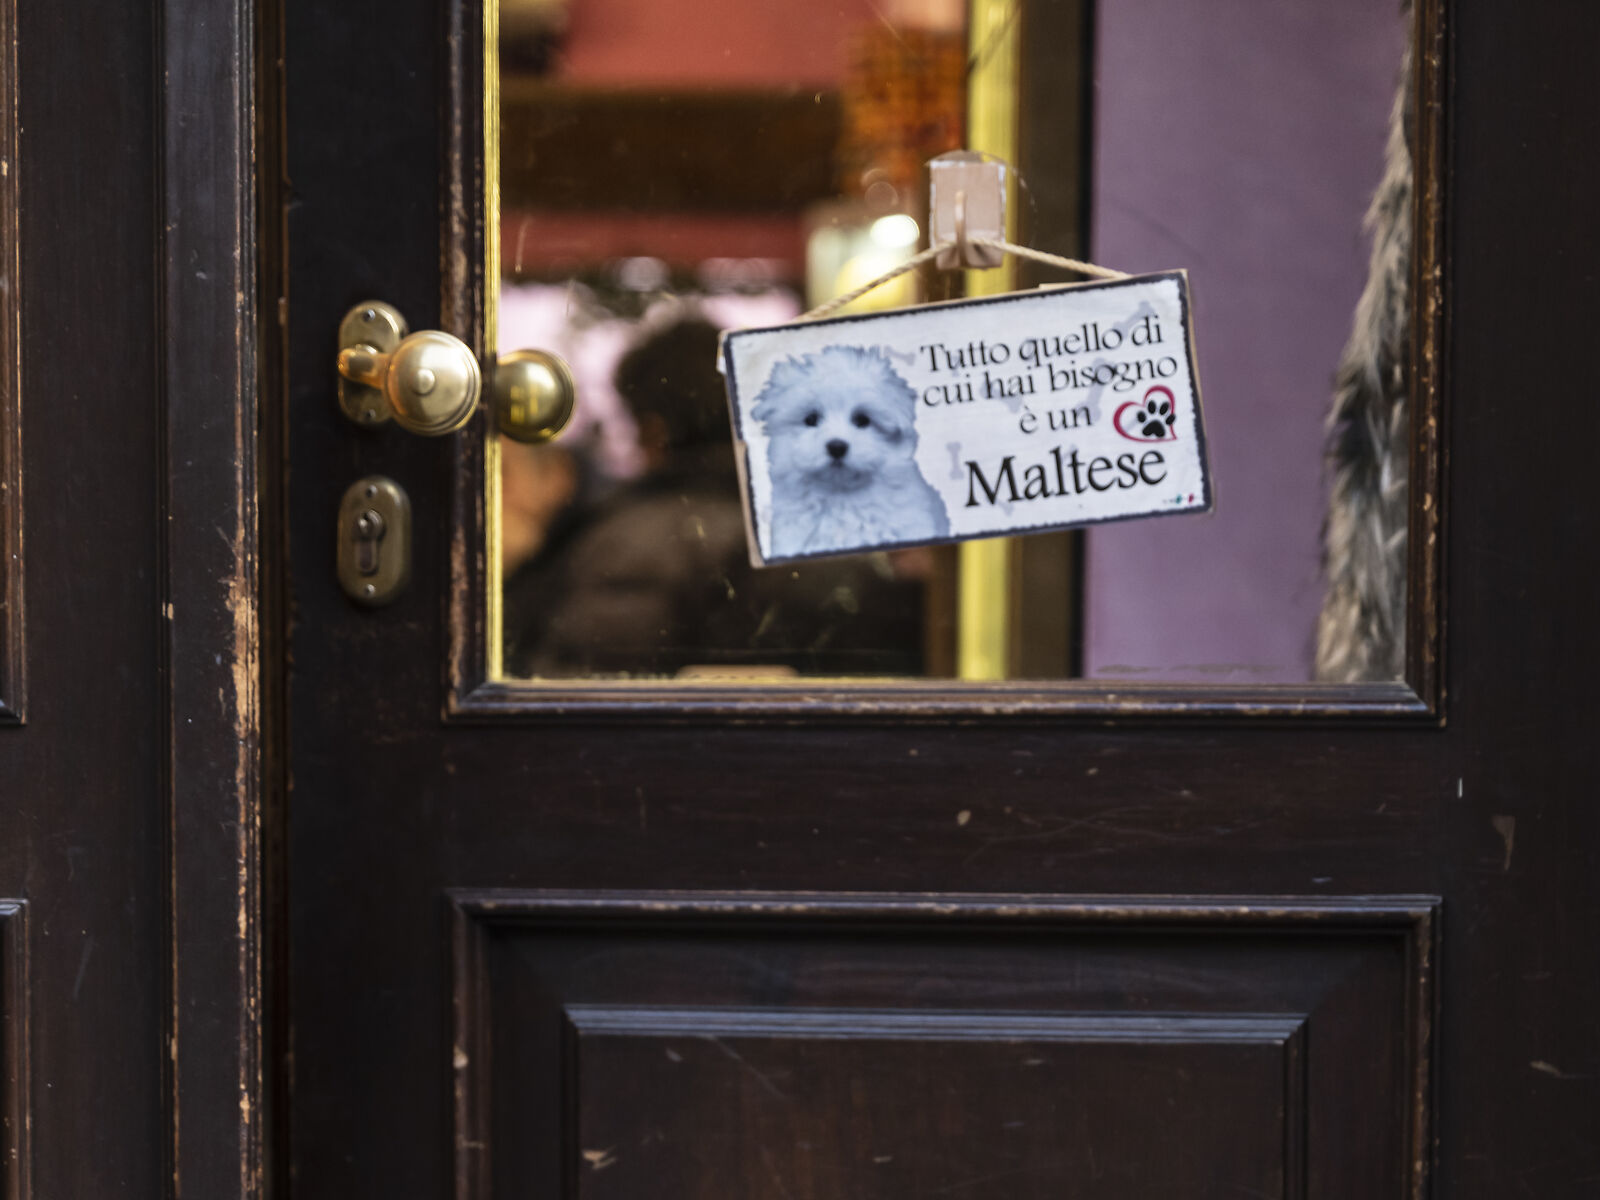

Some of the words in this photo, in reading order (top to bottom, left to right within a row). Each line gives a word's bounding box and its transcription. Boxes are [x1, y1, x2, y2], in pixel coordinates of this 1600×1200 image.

[920, 343, 1010, 372] Tutto
[1018, 322, 1123, 368] quello
[1131, 314, 1164, 347] di
[923, 373, 974, 407] cui
[985, 366, 1036, 400] hai
[1048, 356, 1178, 392] bisogno
[1019, 406, 1039, 434] è
[1047, 405, 1093, 431] un
[965, 445, 1168, 508] Maltese
